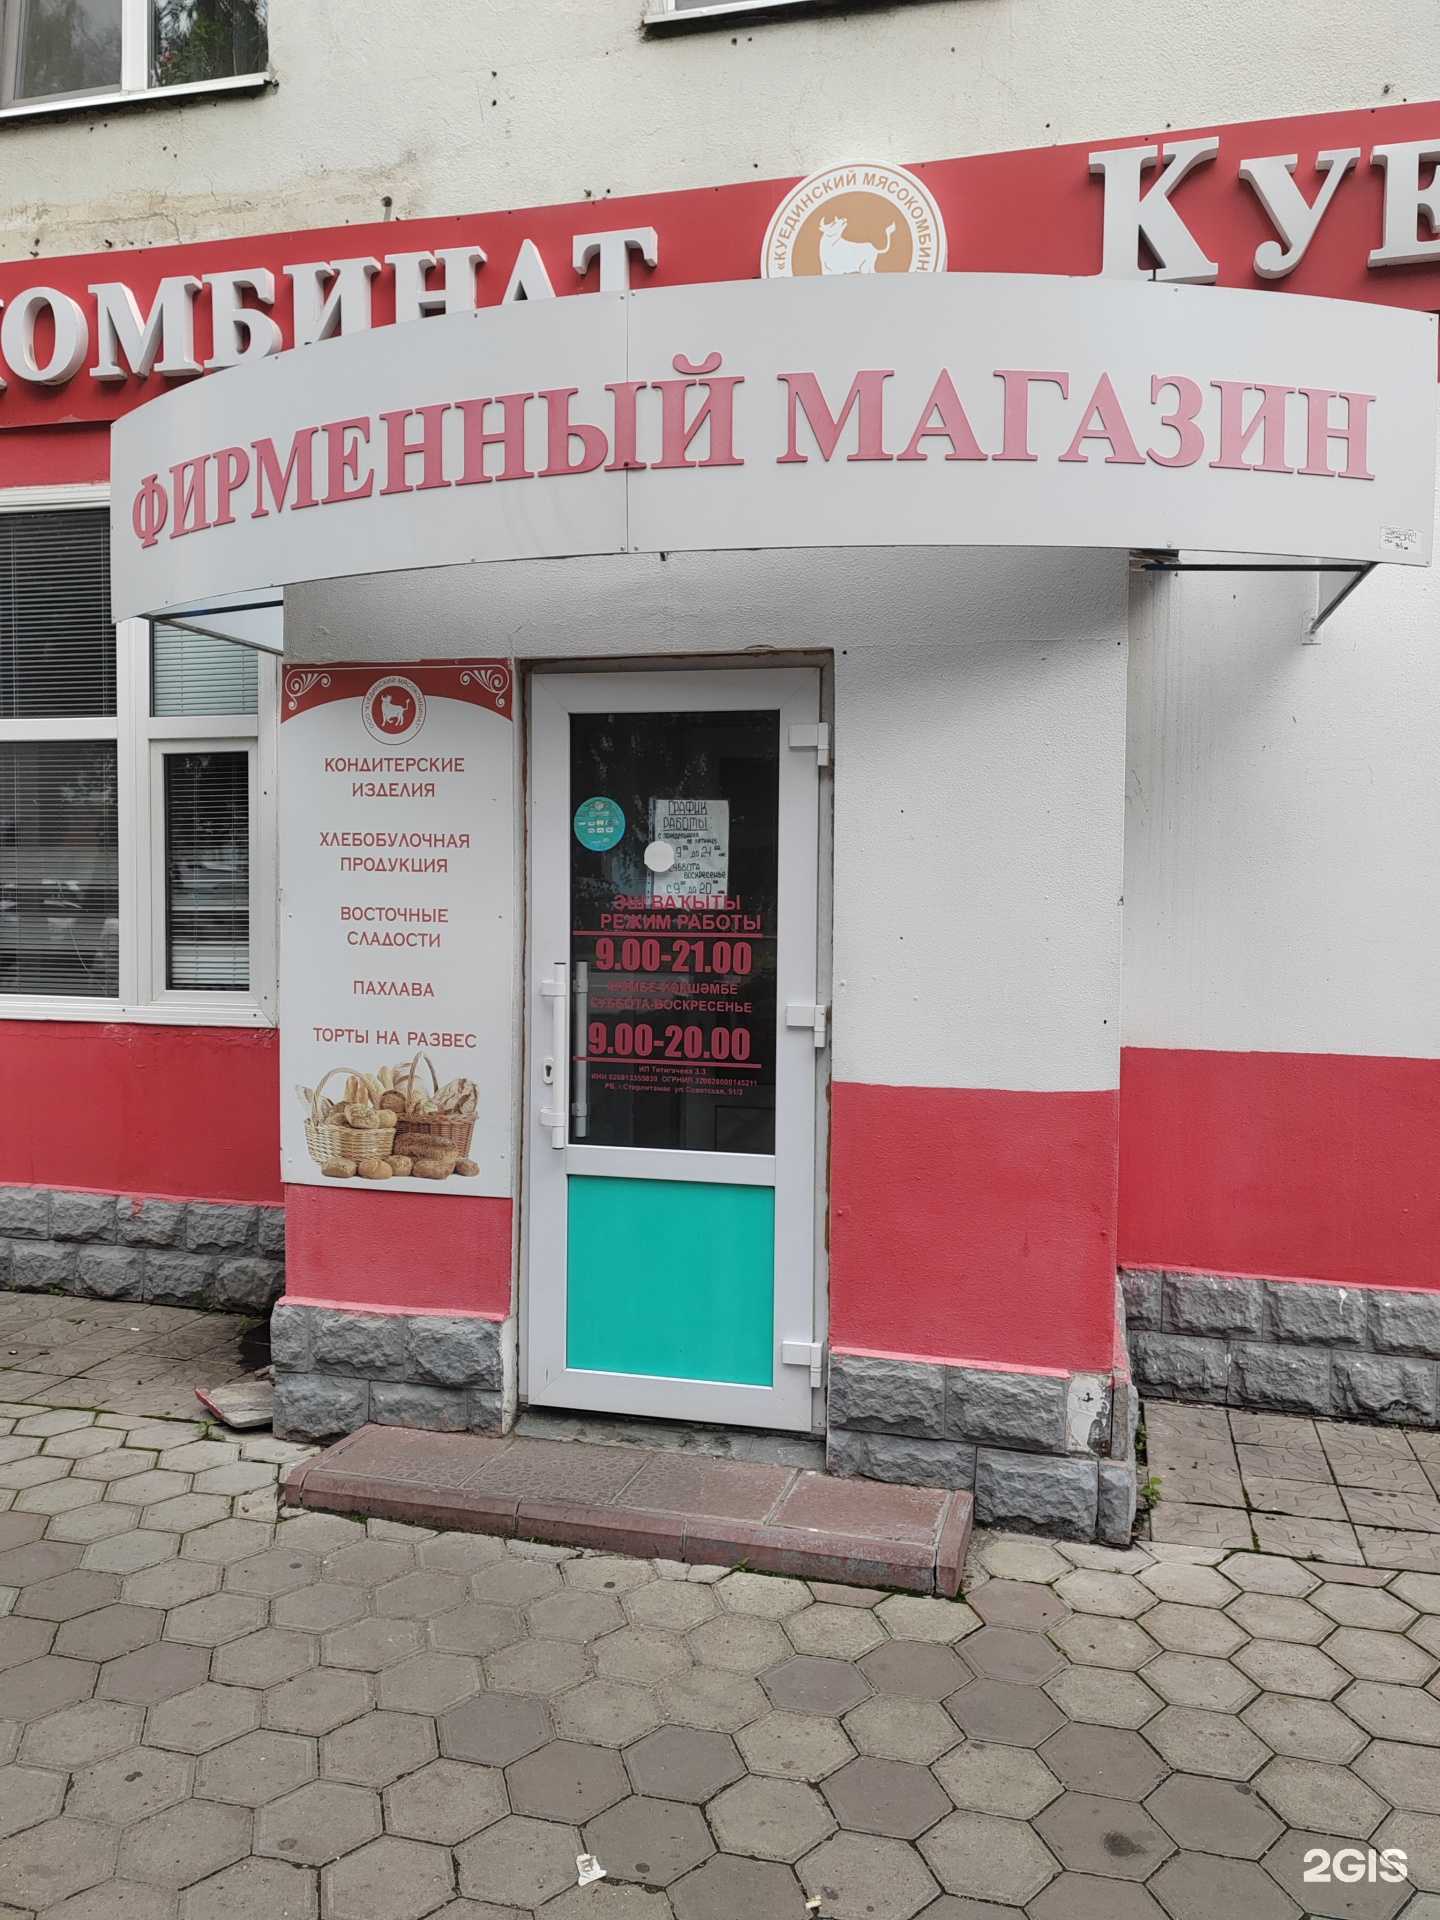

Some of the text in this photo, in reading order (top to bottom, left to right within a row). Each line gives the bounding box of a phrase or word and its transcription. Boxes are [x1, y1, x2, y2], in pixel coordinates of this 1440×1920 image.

[0, 226, 658, 387] ОМБИНАТ
[131, 351, 1377, 549] ФИРМЕННЫЙ МАГАЗИН
[324, 757, 465, 773] КОНДИТЕРСКИЕ
[352, 782, 435, 798] ИЗДЕЛИЯ
[319, 832, 470, 848] ХЛЕБОБУЛОЧНАЯ
[340, 857, 449, 873] ПРОДУКЦИЯ
[340, 906, 449, 923] ВОСТОЧНЫЕ
[600, 913, 761, 931] РЕЖИМ РАБОТЫ
[347, 931, 441, 948] СЛАДОСТИ
[595, 938, 752, 975] 9.00-21.00
[353, 980, 435, 997] ПАХЛАВА
[313, 1027, 477, 1048] ТОРТЫ НА РАЗВЕС
[588, 1022, 751, 1061] 9.00-20.00
